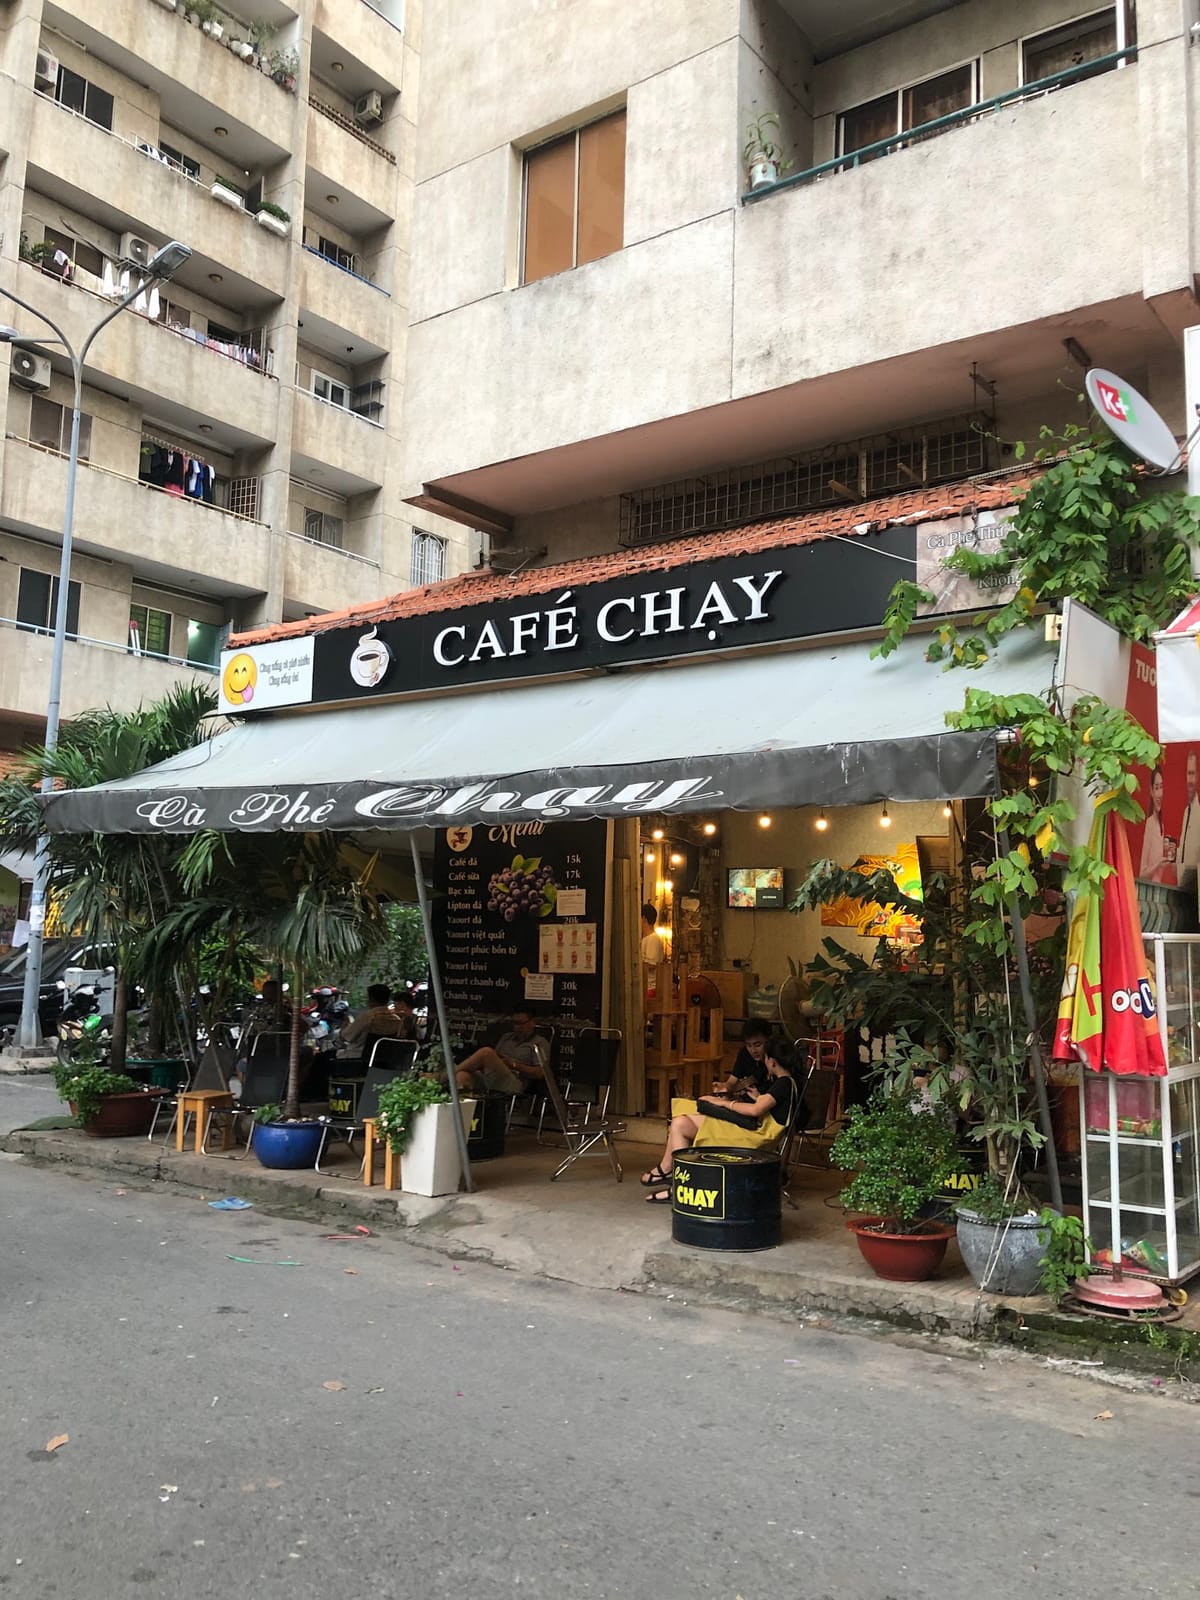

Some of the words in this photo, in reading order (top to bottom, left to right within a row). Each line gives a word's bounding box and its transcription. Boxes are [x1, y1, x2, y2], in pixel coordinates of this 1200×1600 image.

[1100, 387, 1129, 416] K+
[433, 590, 579, 667] CAFÉ
[596, 570, 783, 642] CHẠY
[136, 795, 206, 827] Cà
[229, 791, 338, 825] Phê
[566, 854, 581, 863] 15k
[565, 869, 581, 879] 17k
[447, 900, 471, 911] Lipton
[560, 980, 578, 991] 30k
[676, 1184, 719, 1211] CHẠY
